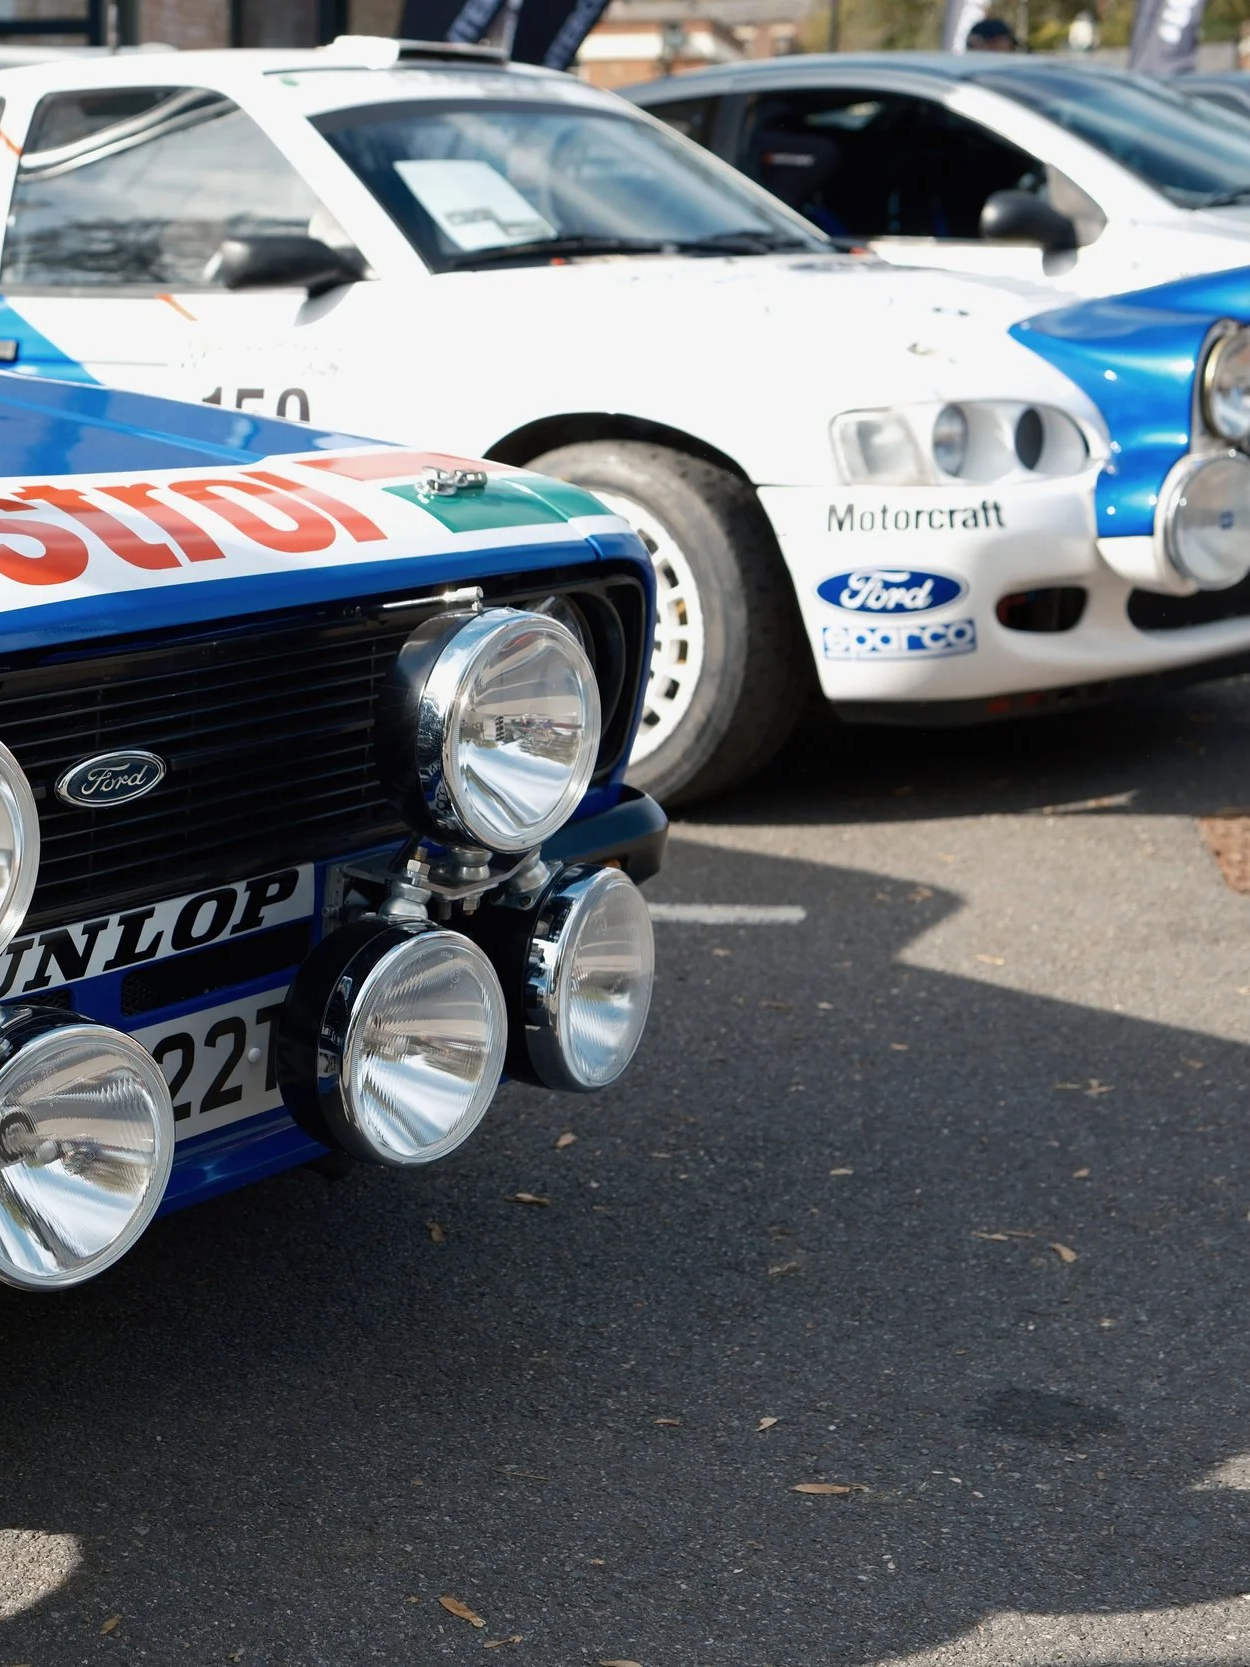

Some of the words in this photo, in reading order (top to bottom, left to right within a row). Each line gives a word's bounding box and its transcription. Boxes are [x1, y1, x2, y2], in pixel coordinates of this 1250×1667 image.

[827, 499, 1007, 532] Motorcraft
[839, 570, 935, 610] Ford
[822, 619, 977, 660] sparco
[80, 762, 149, 796] Ford
